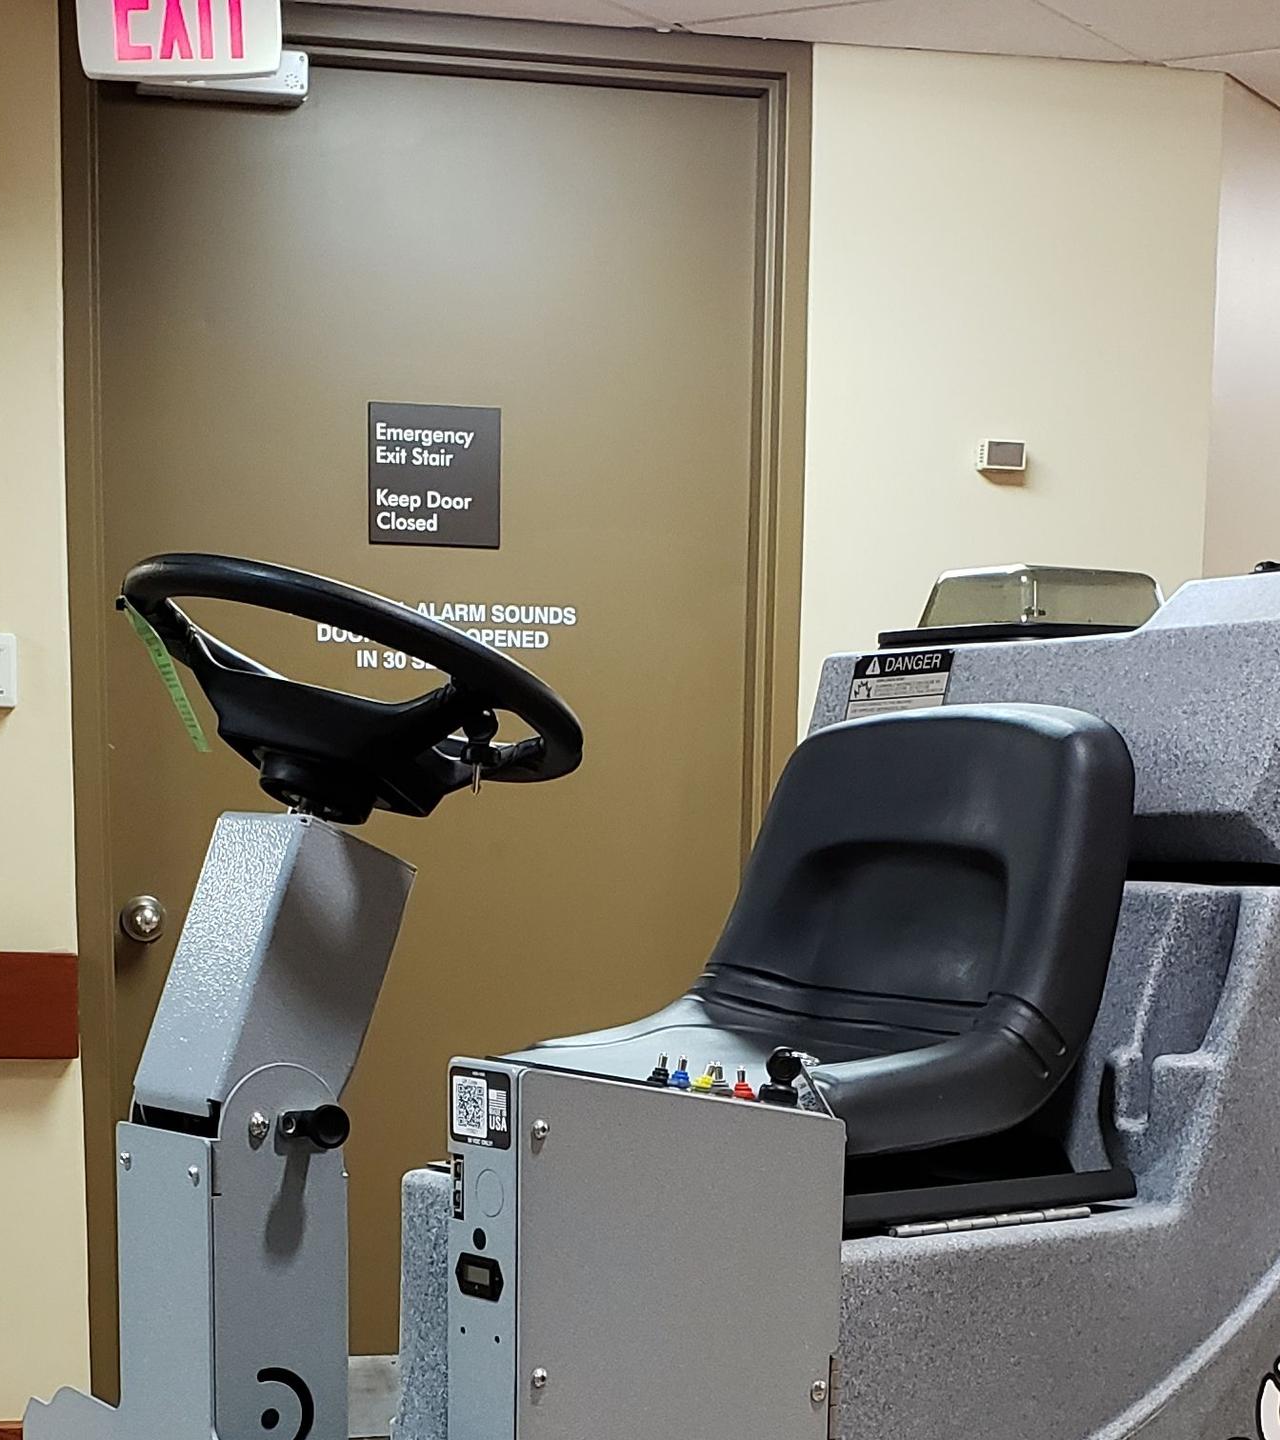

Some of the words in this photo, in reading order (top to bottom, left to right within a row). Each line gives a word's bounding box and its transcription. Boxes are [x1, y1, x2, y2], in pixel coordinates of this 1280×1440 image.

[376, 422, 474, 448] Emergency
[376, 446, 407, 464] Exit
[412, 448, 454, 466] Stair
[376, 488, 421, 512] Keep
[427, 491, 472, 509] Door
[376, 512, 438, 531] Closed
[417, 602, 486, 622] ALARM
[491, 604, 577, 625] SOUNDS
[356, 649, 378, 668] IN
[383, 650, 407, 669] 30
[884, 653, 942, 673] DANGER
[489, 1115, 508, 1133] USA
